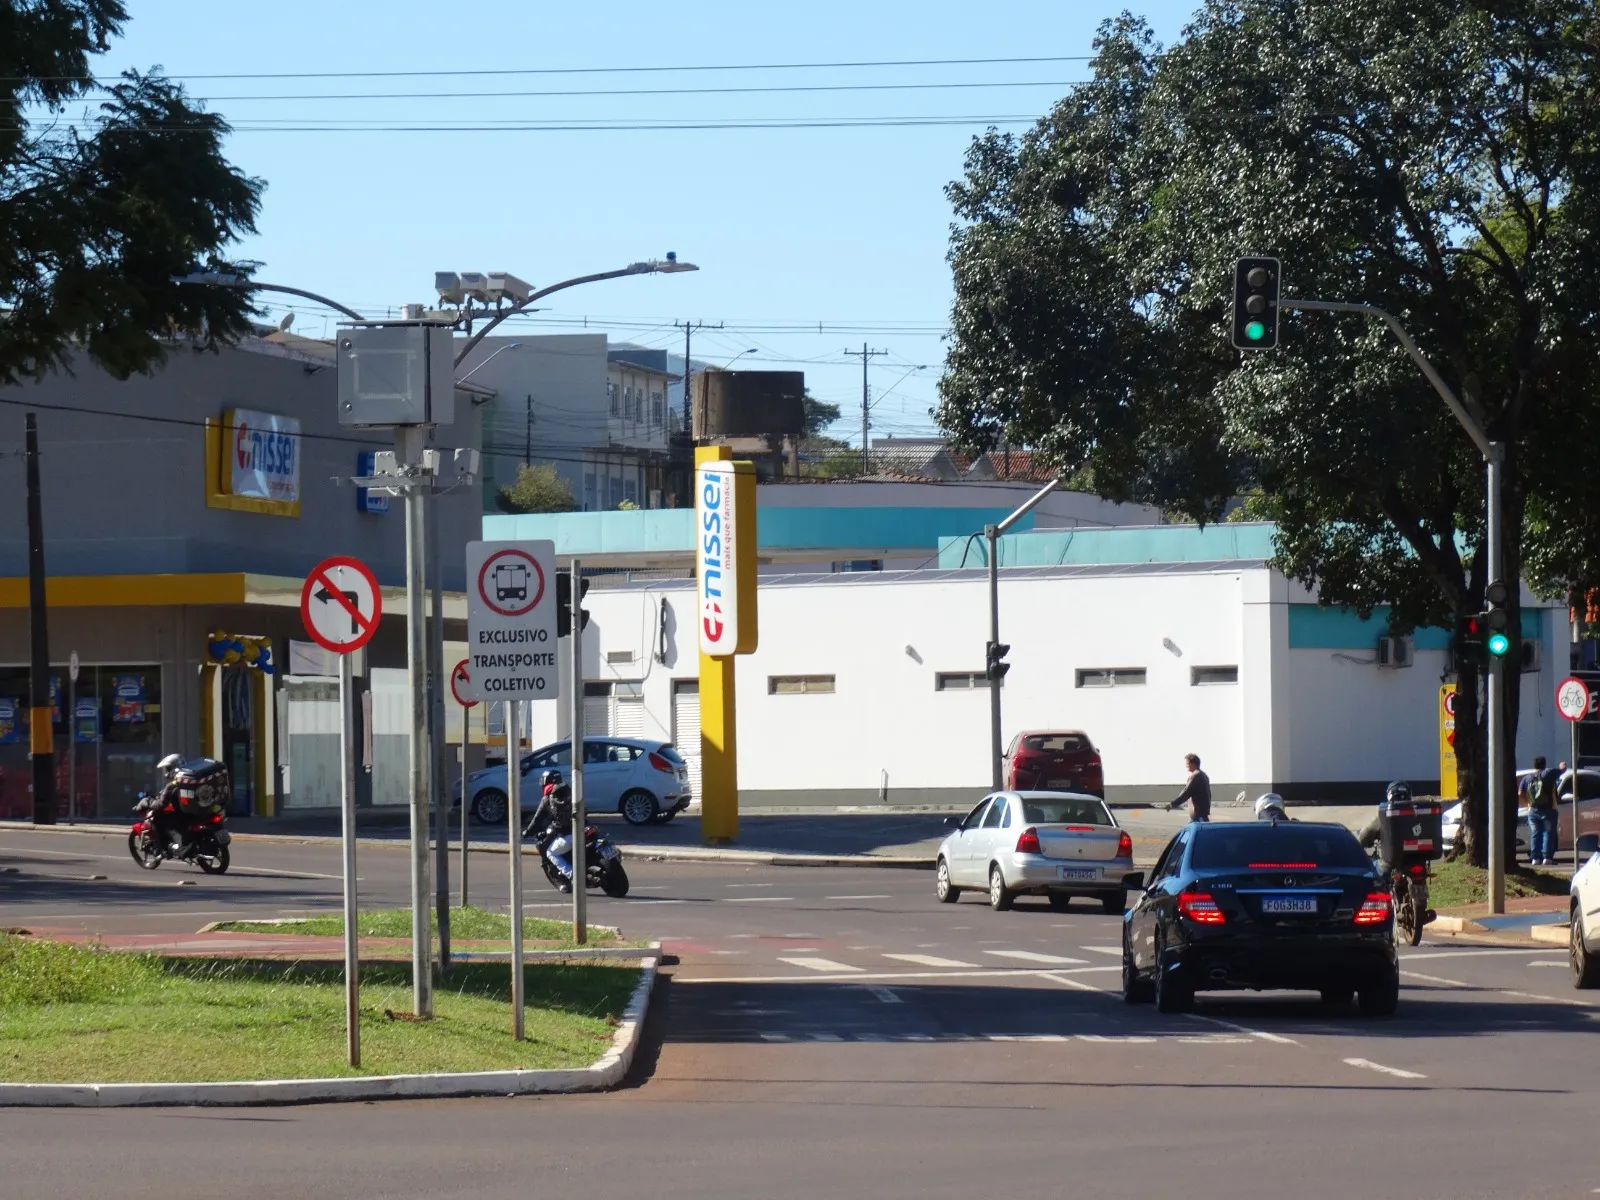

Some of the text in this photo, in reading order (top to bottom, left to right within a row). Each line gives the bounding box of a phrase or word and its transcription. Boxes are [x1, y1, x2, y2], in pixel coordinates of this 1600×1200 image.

[703, 473, 721, 598] nissei
[479, 629, 548, 643] EXCLUSIVO
[474, 653, 554, 668] TRANSPORTE
[484, 677, 546, 691] COLETIVO
[1267, 900, 1312, 911] FOG3H38
